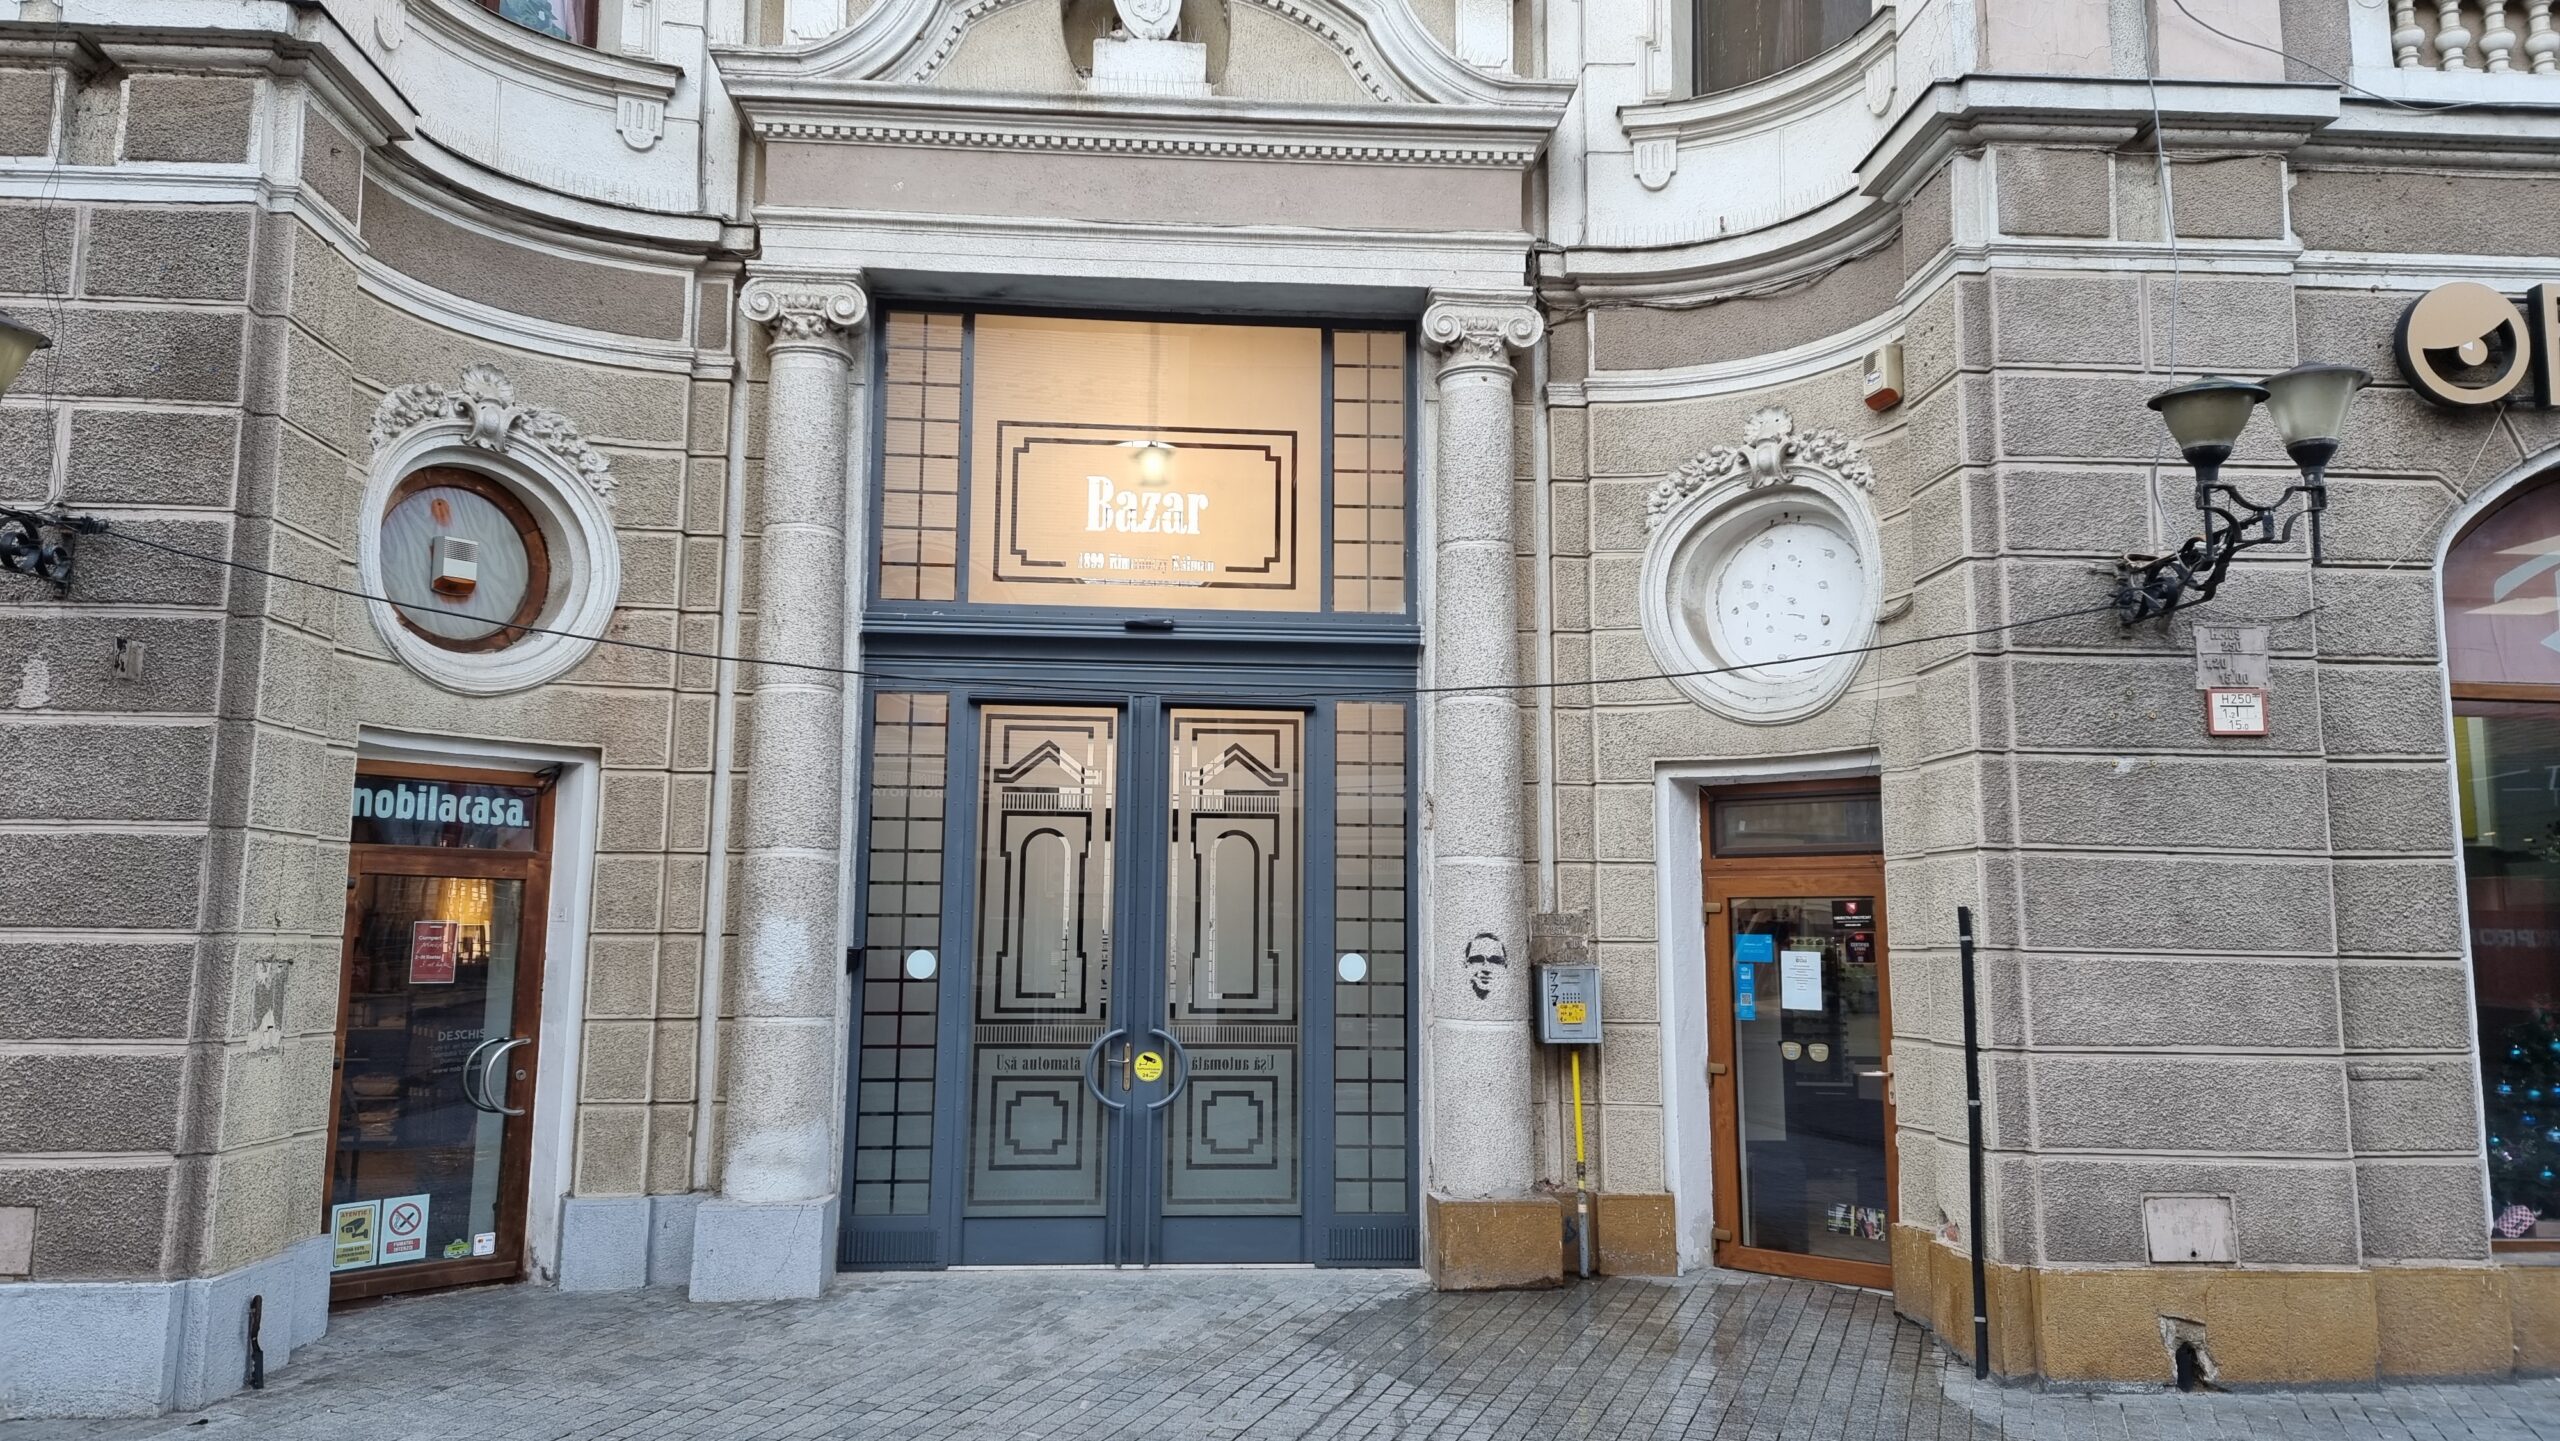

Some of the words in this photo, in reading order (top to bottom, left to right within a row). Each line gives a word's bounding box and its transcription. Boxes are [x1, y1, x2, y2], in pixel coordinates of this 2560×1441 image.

[1085, 475, 1209, 535] Bazar
[1078, 553, 1105, 569] 1899
[2221, 693, 2252, 705] H250
